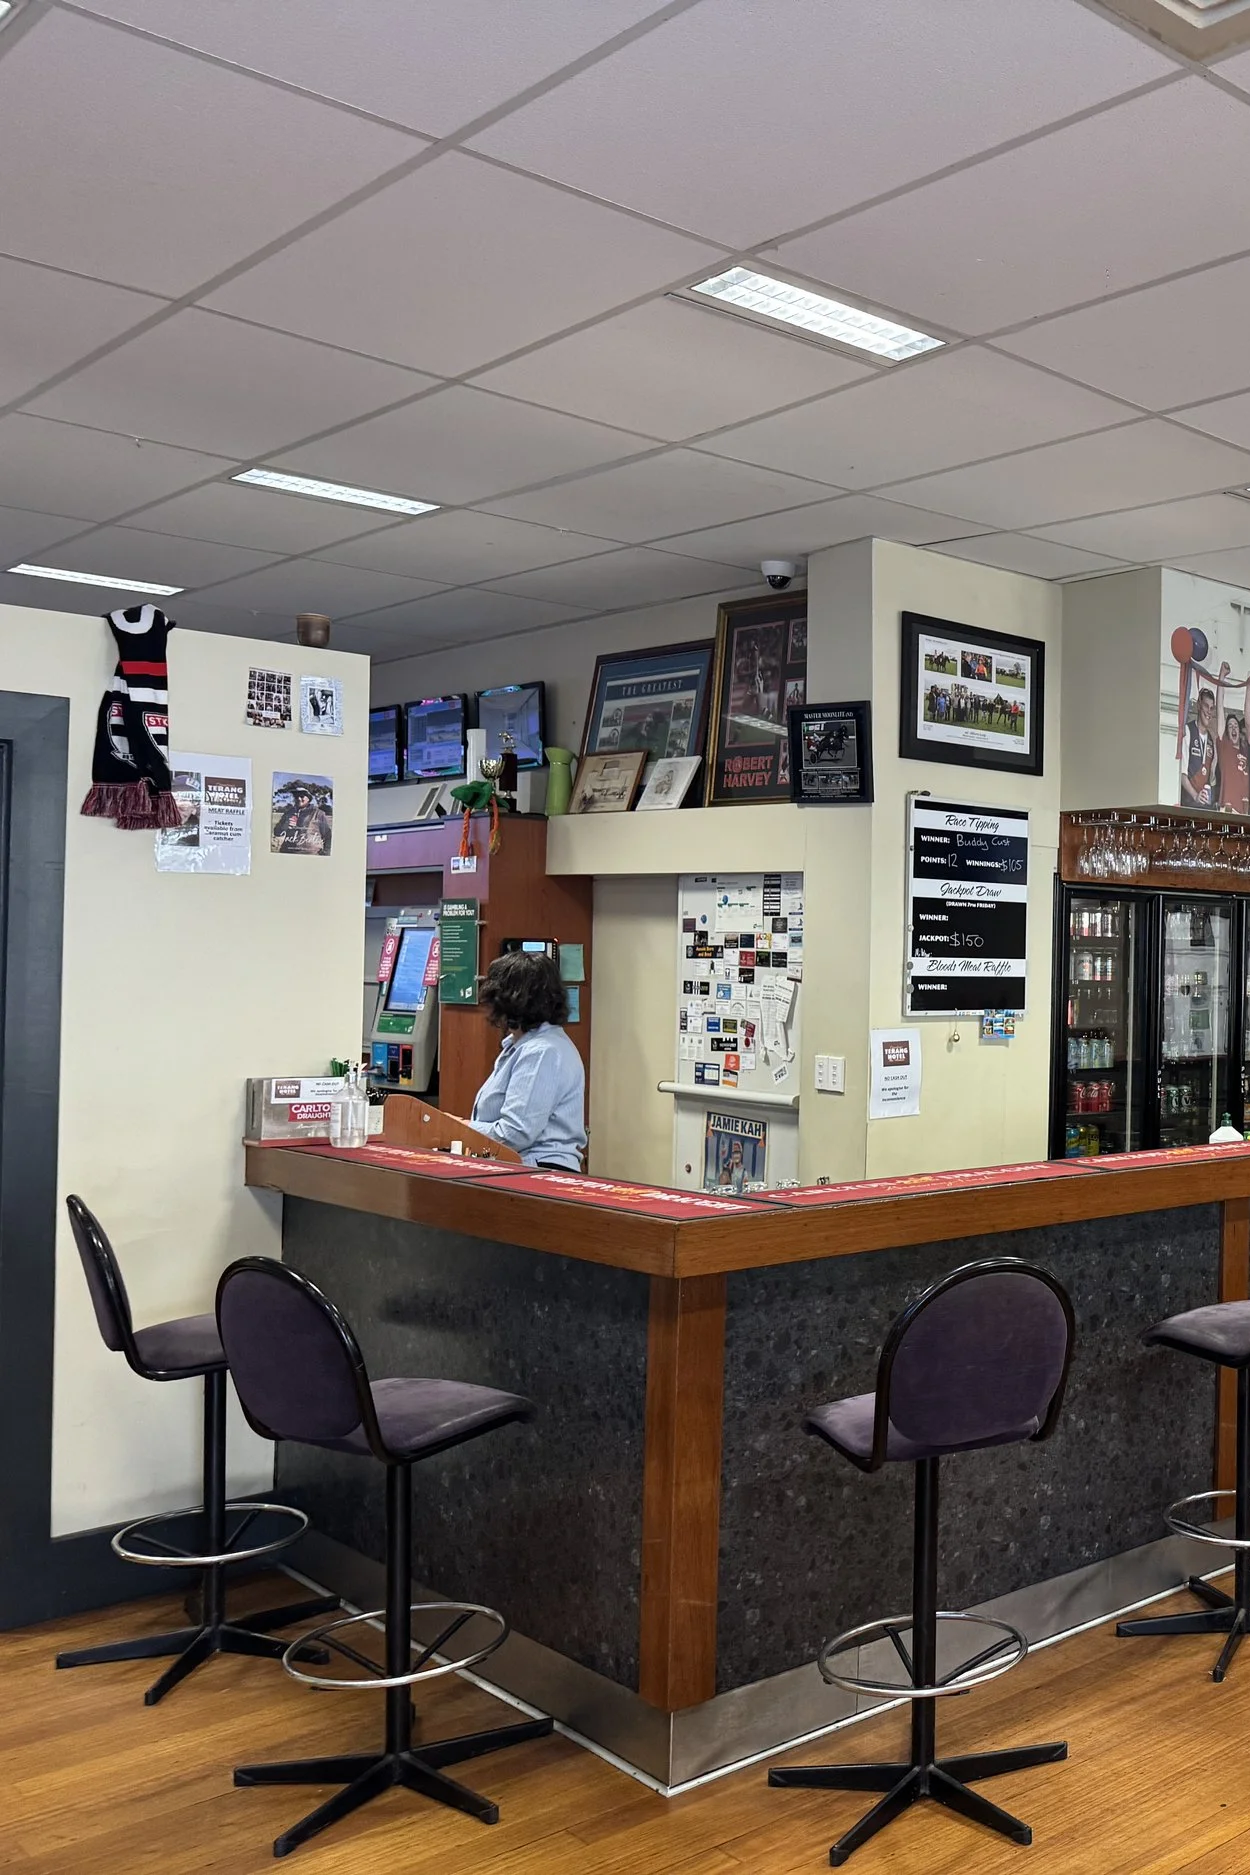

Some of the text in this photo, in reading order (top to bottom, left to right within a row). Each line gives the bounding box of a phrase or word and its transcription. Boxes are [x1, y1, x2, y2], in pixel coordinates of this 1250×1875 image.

[723, 771, 772, 788] HARVEY
[207, 785, 243, 794] TERANG
[969, 817, 1000, 833] Tipping
[920, 834, 950, 844] WINNER:
[956, 833, 989, 851] Buddy
[920, 853, 1023, 872] POINTS: 12 WINNINGS: $105
[940, 882, 1002, 897] Jackpot Draw
[949, 931, 984, 947] $150
[927, 959, 1011, 976] Bloods Meat Raffle
[884, 1047, 908, 1055] TERANG
[291, 1104, 331, 1113] CARLTO
[711, 1115, 761, 1137] JAMIE KAH
